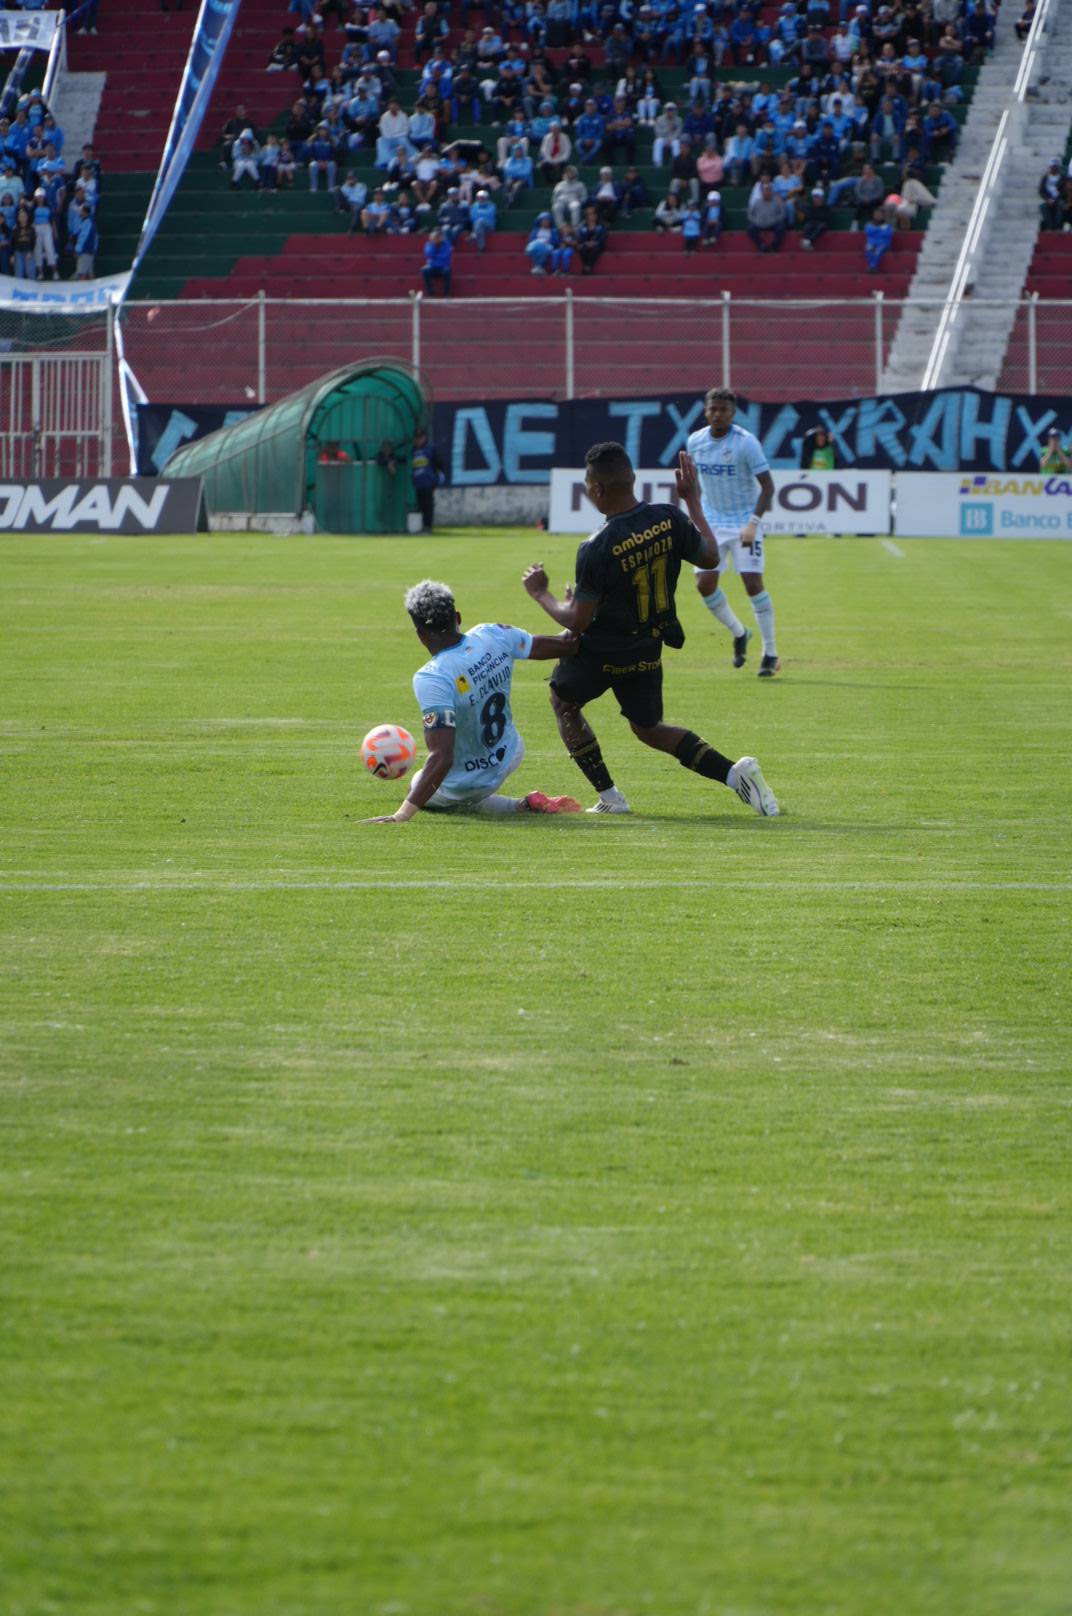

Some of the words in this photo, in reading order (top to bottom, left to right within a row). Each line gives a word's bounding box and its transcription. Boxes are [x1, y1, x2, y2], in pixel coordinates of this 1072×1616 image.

[451, 403, 559, 485] DE
[1001, 511, 1061, 528] Banco
[632, 556, 670, 624] 11
[468, 652, 492, 676] BANCO
[481, 692, 506, 747] 8
